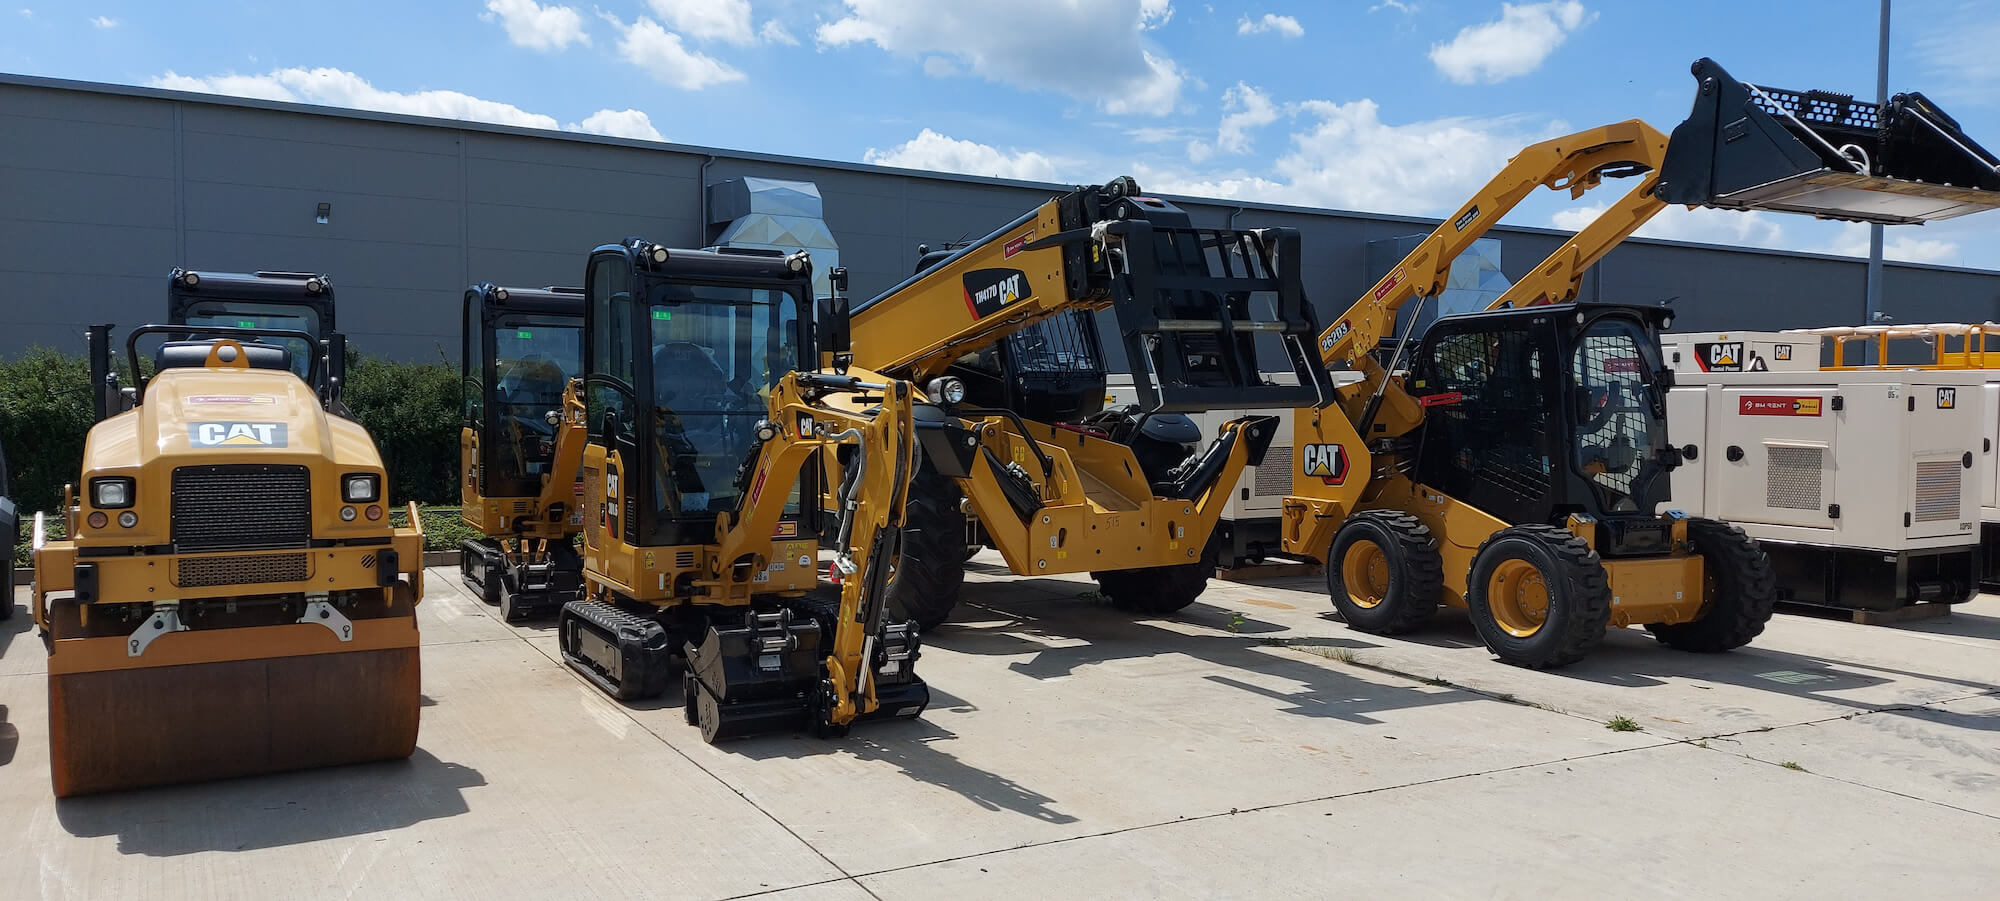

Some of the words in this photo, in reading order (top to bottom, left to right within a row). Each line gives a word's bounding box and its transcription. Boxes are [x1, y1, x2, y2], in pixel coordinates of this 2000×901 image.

[975, 284, 998, 305] TH417D
[999, 273, 1020, 305] CAT
[1321, 322, 1349, 353] 262D3
[1711, 344, 1741, 365] CAT
[1776, 345, 1791, 360] CAT
[1938, 389, 1954, 408] CAT
[198, 423, 276, 446] CAT
[801, 418, 813, 437] CAT
[1304, 444, 1339, 476] CAT
[607, 473, 618, 499] CAT
